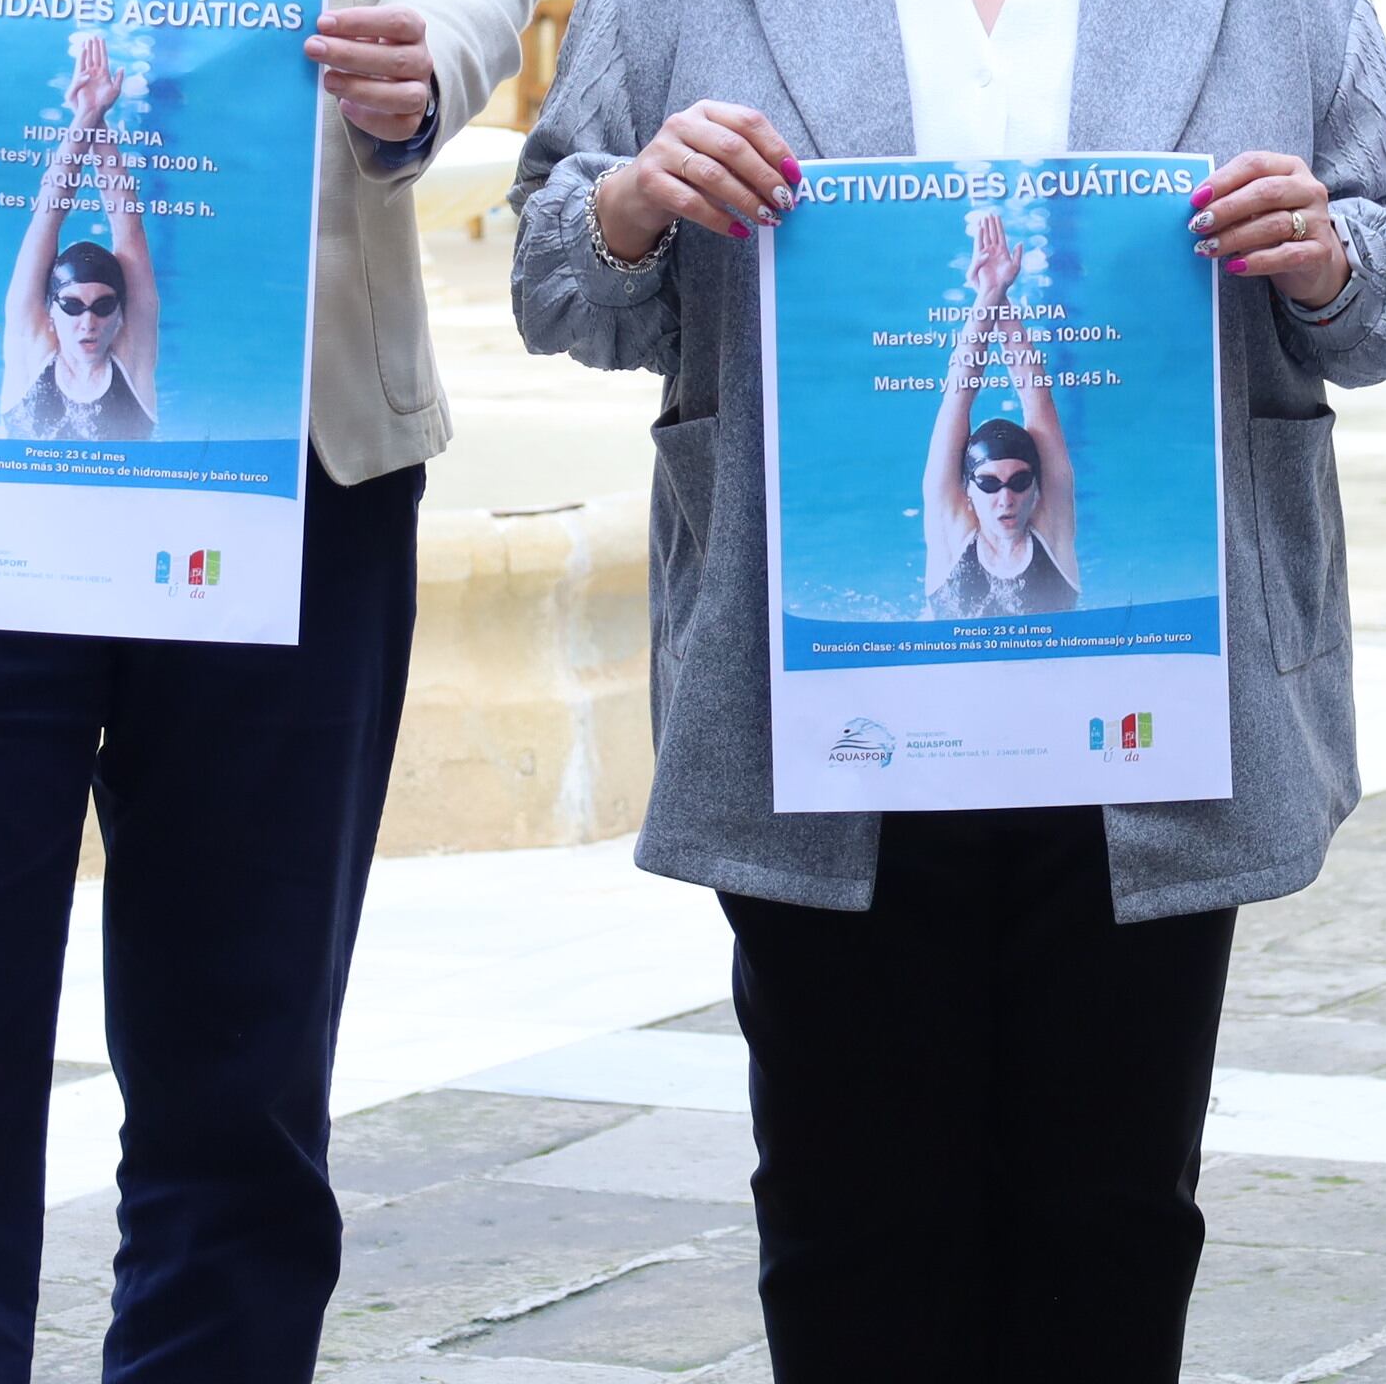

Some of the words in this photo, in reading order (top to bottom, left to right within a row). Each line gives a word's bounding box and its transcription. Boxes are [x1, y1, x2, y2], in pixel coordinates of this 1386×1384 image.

[24, 125, 163, 146] HIDROTERAPIA
[31, 153, 42, 167] y
[46, 150, 102, 168] jueves
[107, 155, 117, 167] a
[122, 152, 147, 168] las
[152, 154, 197, 170] 10:00
[202, 155, 218, 172] h.
[40, 172, 141, 192] AQUAGYM:
[798, 172, 1006, 202] ACTIVIDADES
[1014, 163, 1193, 197] ACUÁTICAS
[30, 197, 40, 211] y
[43, 195, 100, 213] jueves
[105, 200, 116, 212] a
[120, 197, 145, 213] las
[150, 198, 195, 215] 18:45
[200, 201, 215, 217] h.
[928, 304, 1066, 323] HIDROTERAPIA
[872, 330, 932, 346] Martes
[936, 333, 946, 347] y
[950, 328, 1007, 347] jueves
[1011, 331, 1022, 342] a
[1027, 327, 1052, 343] las
[1056, 325, 1102, 341] 10:00
[1106, 324, 1122, 341] h.
[948, 350, 1047, 369] AQUAGYM:
[874, 375, 934, 392] Martes
[939, 378, 949, 392] y
[953, 373, 1009, 392] jueves
[1014, 376, 1024, 388] a
[1028, 371, 1053, 387] las
[1057, 371, 1102, 386] 18:45
[1105, 369, 1121, 385] h.
[25, 447, 63, 458] Precio:
[65, 450, 79, 459] 23
[81, 451, 88, 459] €
[90, 451, 100, 460] al
[103, 454, 126, 462] mes
[30, 461, 52, 472] más
[56, 463, 68, 473] 30
[71, 464, 114, 475] minutos
[117, 466, 130, 476] de
[133, 467, 199, 481] hidromasaje
[201, 471, 208, 481] y
[211, 470, 237, 481] baño
[240, 472, 268, 482] turco
[953, 627, 991, 636] Precio:
[993, 626, 1006, 635] 23
[1008, 626, 1015, 634] €
[1018, 625, 1028, 634] al
[1030, 626, 1052, 634] mes
[813, 642, 860, 653] Duración
[863, 641, 895, 652] Clase:
[898, 641, 911, 651] 45
[914, 640, 957, 650] minutos
[960, 639, 982, 650] más
[984, 639, 997, 649] 30
[1000, 638, 1042, 648] minutos
[1045, 637, 1058, 647] de
[1061, 635, 1125, 647] hidromasaje
[1128, 636, 1134, 646] y
[1135, 633, 1162, 644] baño
[1164, 632, 1192, 642] turco
[906, 739, 963, 749] AQUASPORT
[829, 752, 893, 762] AQUASPORT
